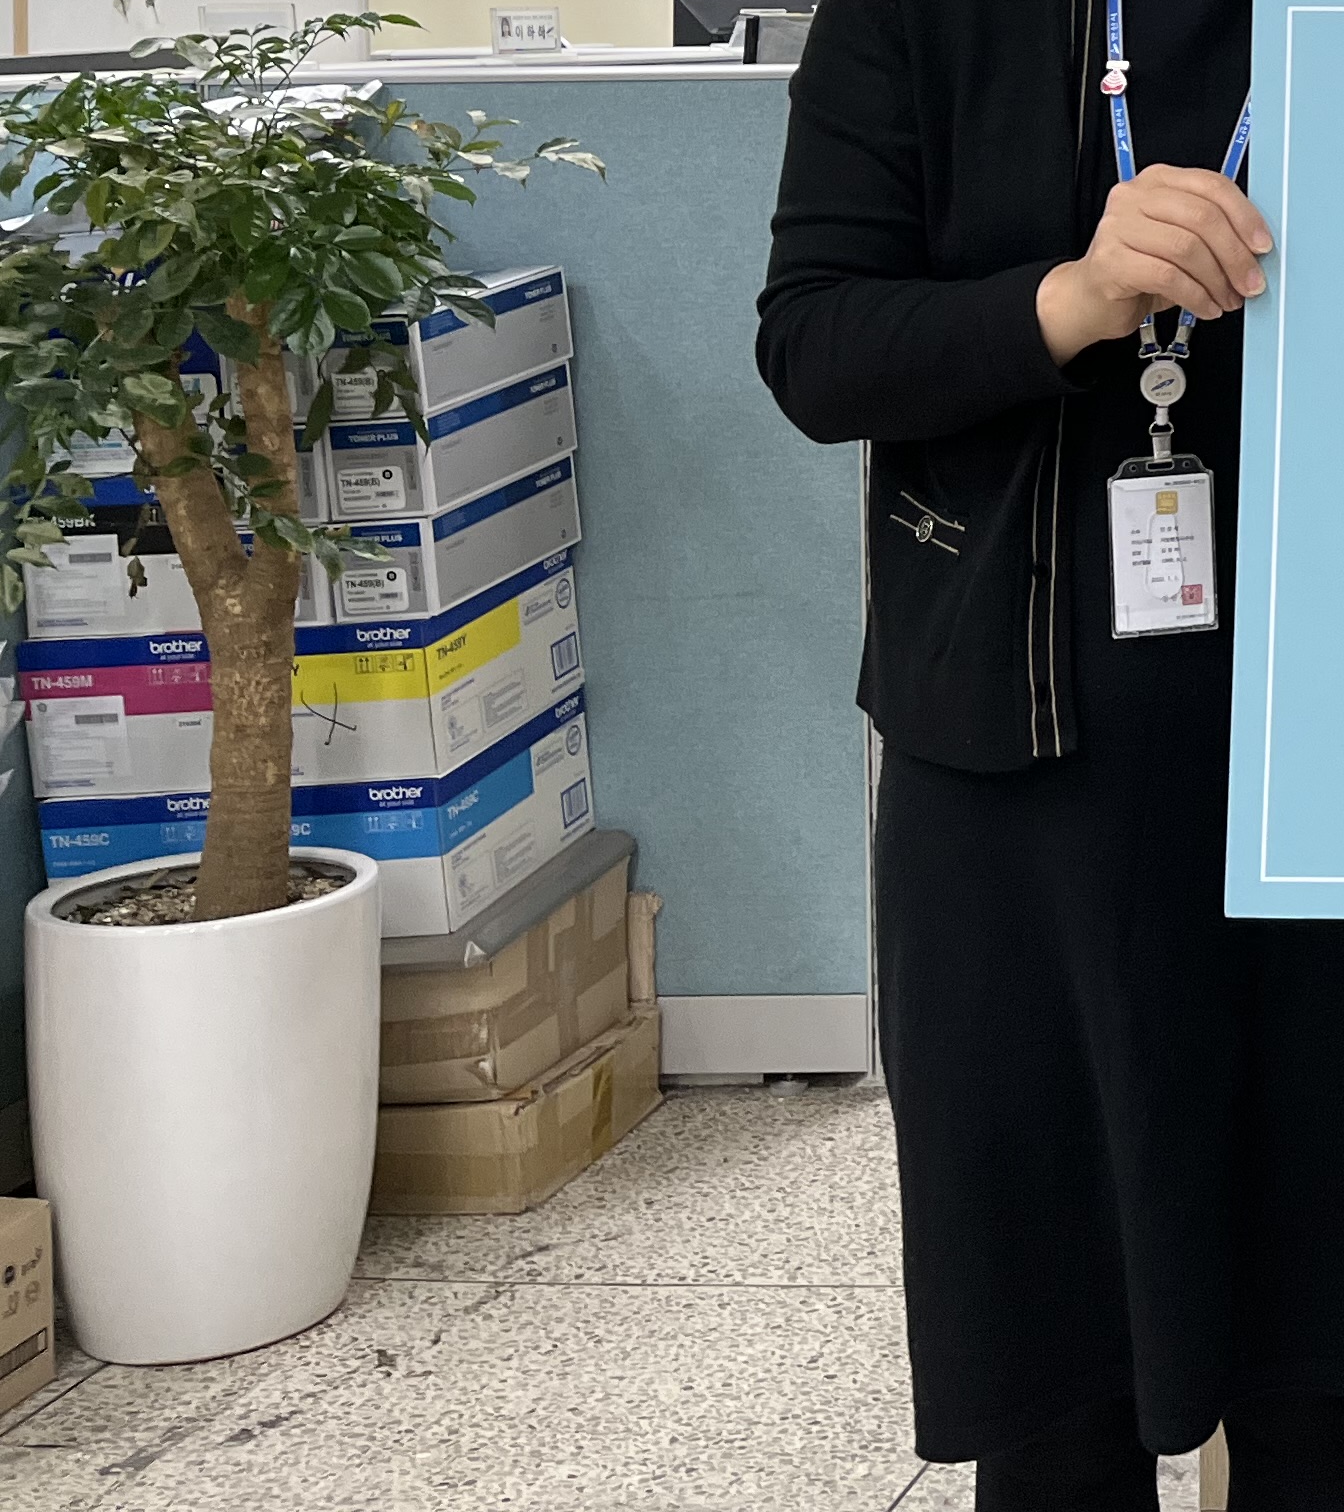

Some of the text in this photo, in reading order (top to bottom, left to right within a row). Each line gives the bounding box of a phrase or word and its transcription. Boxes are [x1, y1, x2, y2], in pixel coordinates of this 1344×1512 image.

[356, 627, 412, 642] brother
[149, 639, 203, 655] brother
[31, 674, 94, 690] TN-459M
[368, 786, 424, 801] brother
